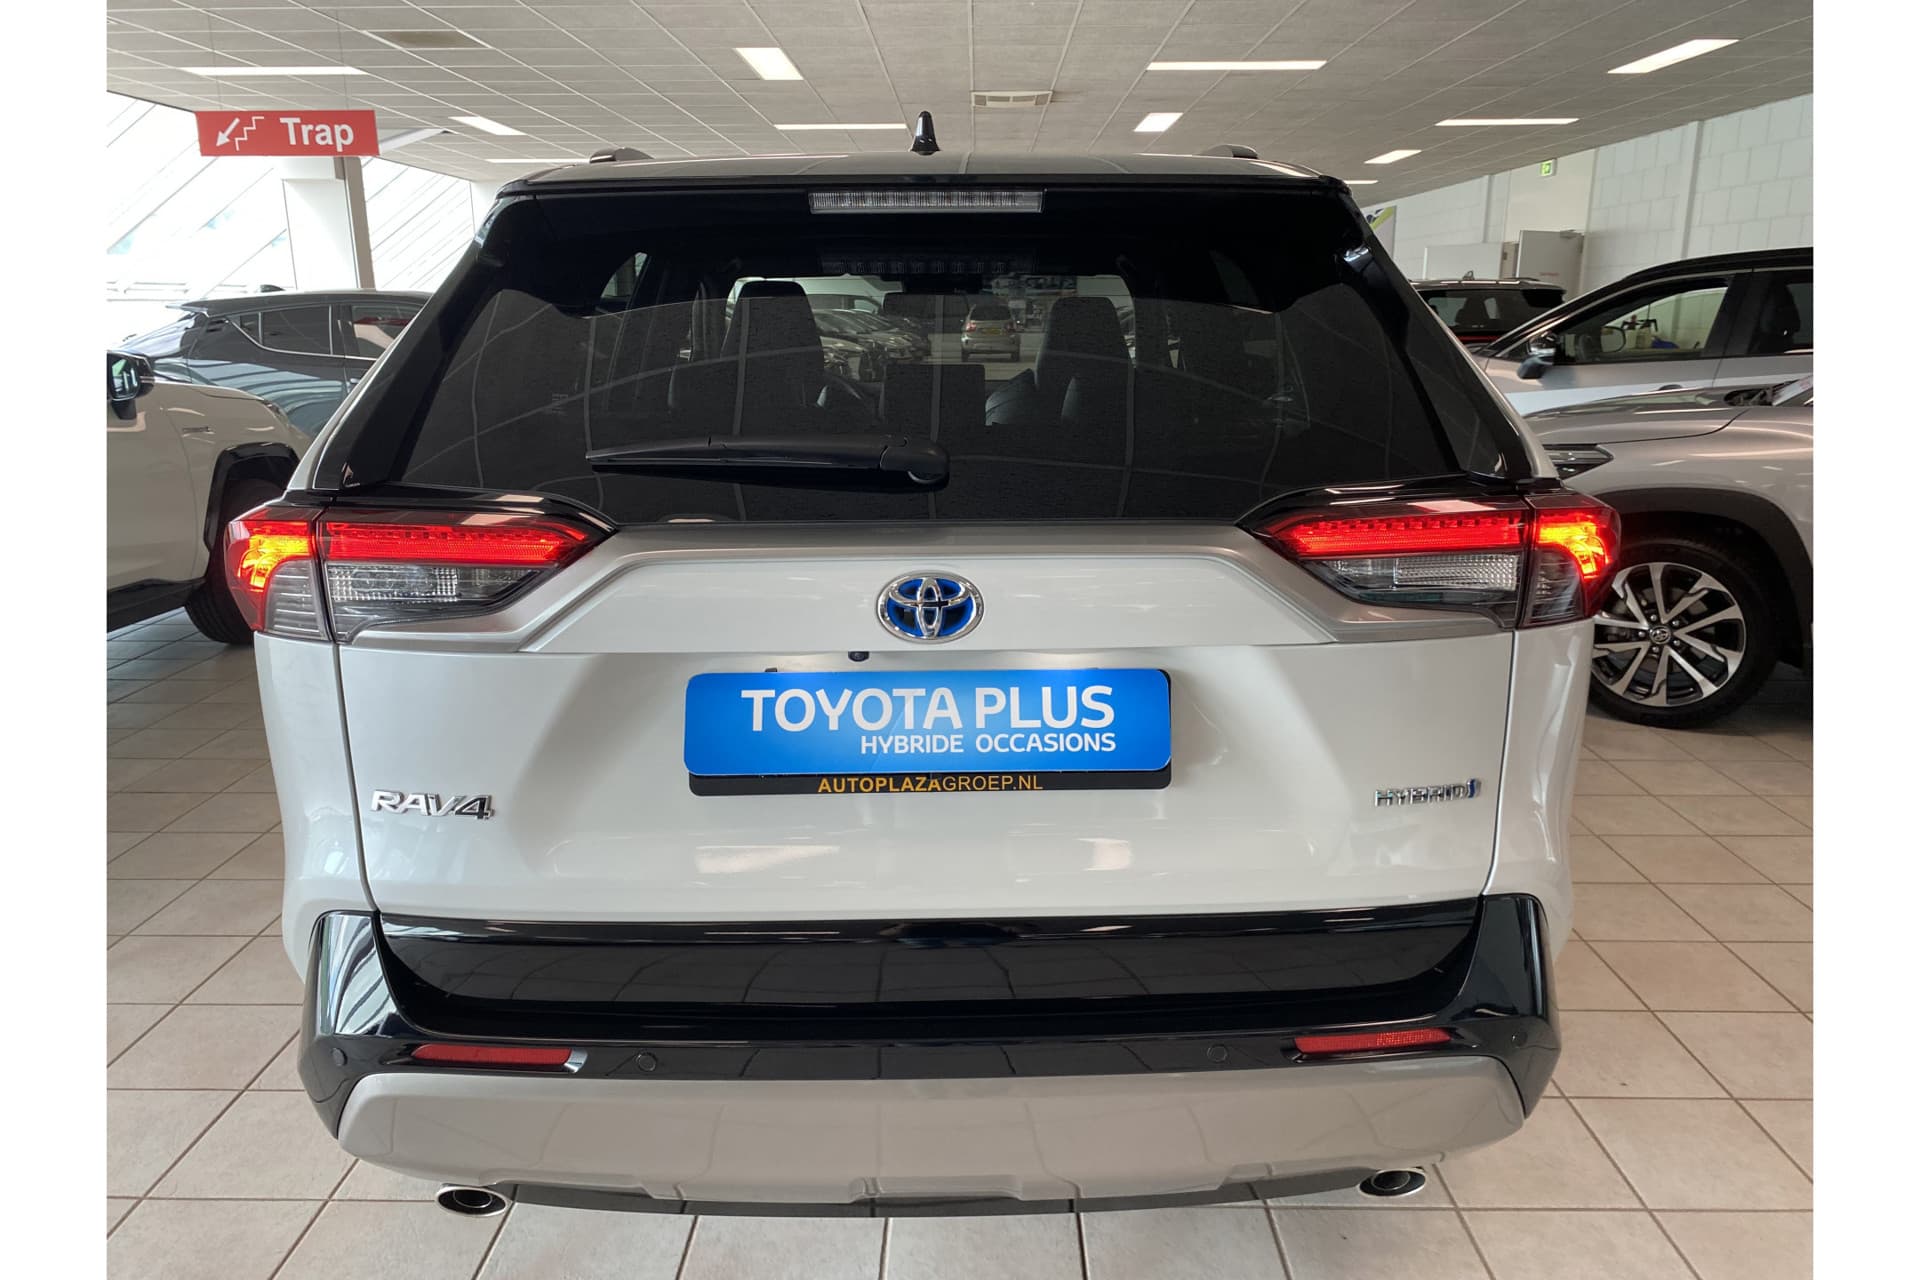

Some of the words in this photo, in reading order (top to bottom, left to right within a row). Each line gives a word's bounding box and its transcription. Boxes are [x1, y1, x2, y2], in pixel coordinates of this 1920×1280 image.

[279, 117, 355, 153] Trap
[741, 687, 963, 732] TOYOTA
[975, 685, 1115, 729] PLUS
[860, 734, 965, 755] HYBRIDE
[975, 732, 1117, 754] OCCASIONS
[817, 775, 1044, 793] AUTOPLAZAGROEP.NL
[370, 789, 495, 821] RAV4
